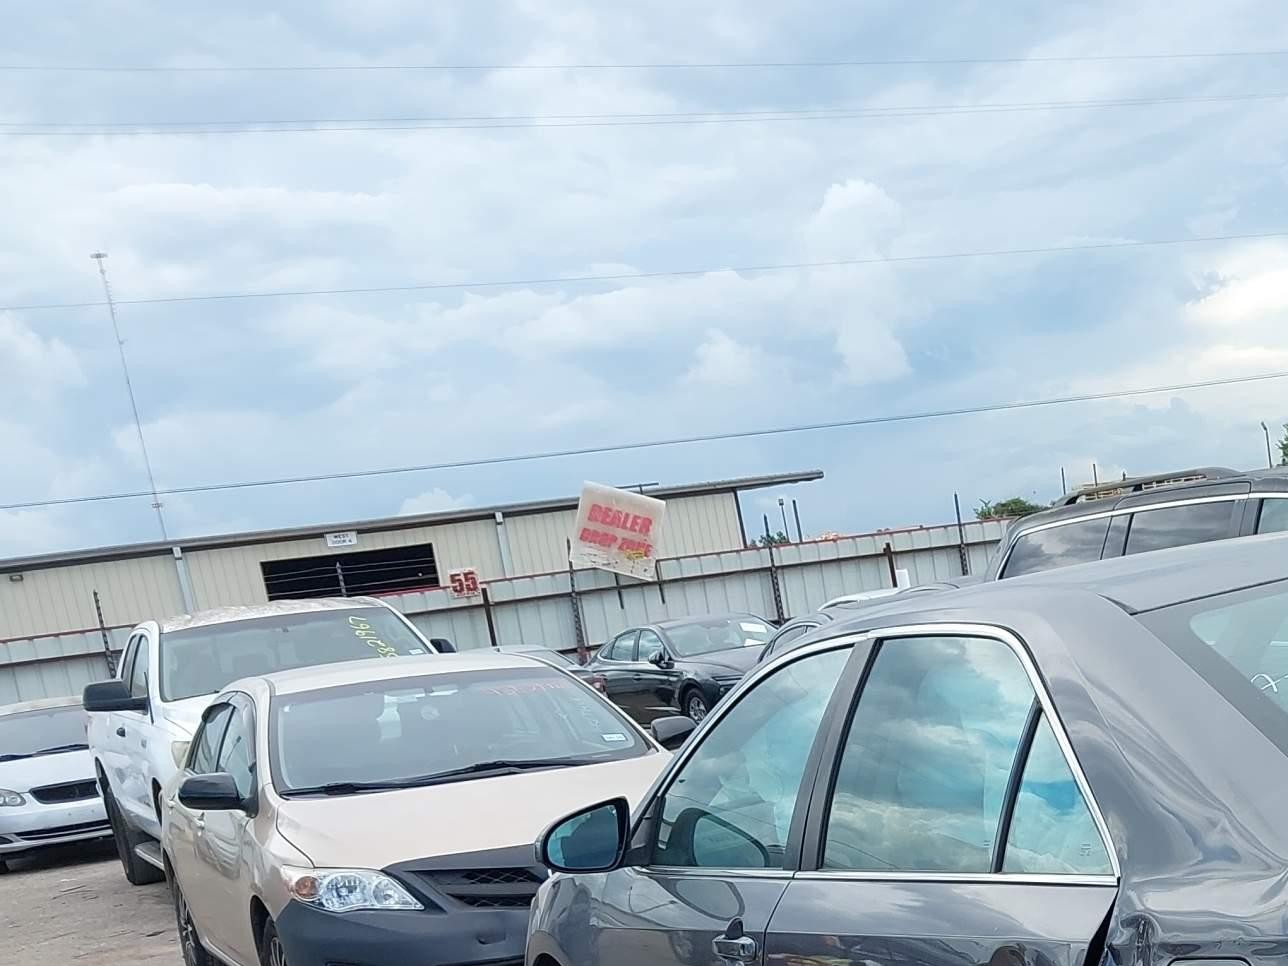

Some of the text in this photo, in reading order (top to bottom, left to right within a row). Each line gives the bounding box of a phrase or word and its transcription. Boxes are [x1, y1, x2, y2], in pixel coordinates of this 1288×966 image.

[588, 503, 652, 535] DEALER
[579, 527, 618, 547] DROP
[450, 571, 478, 593] 55
